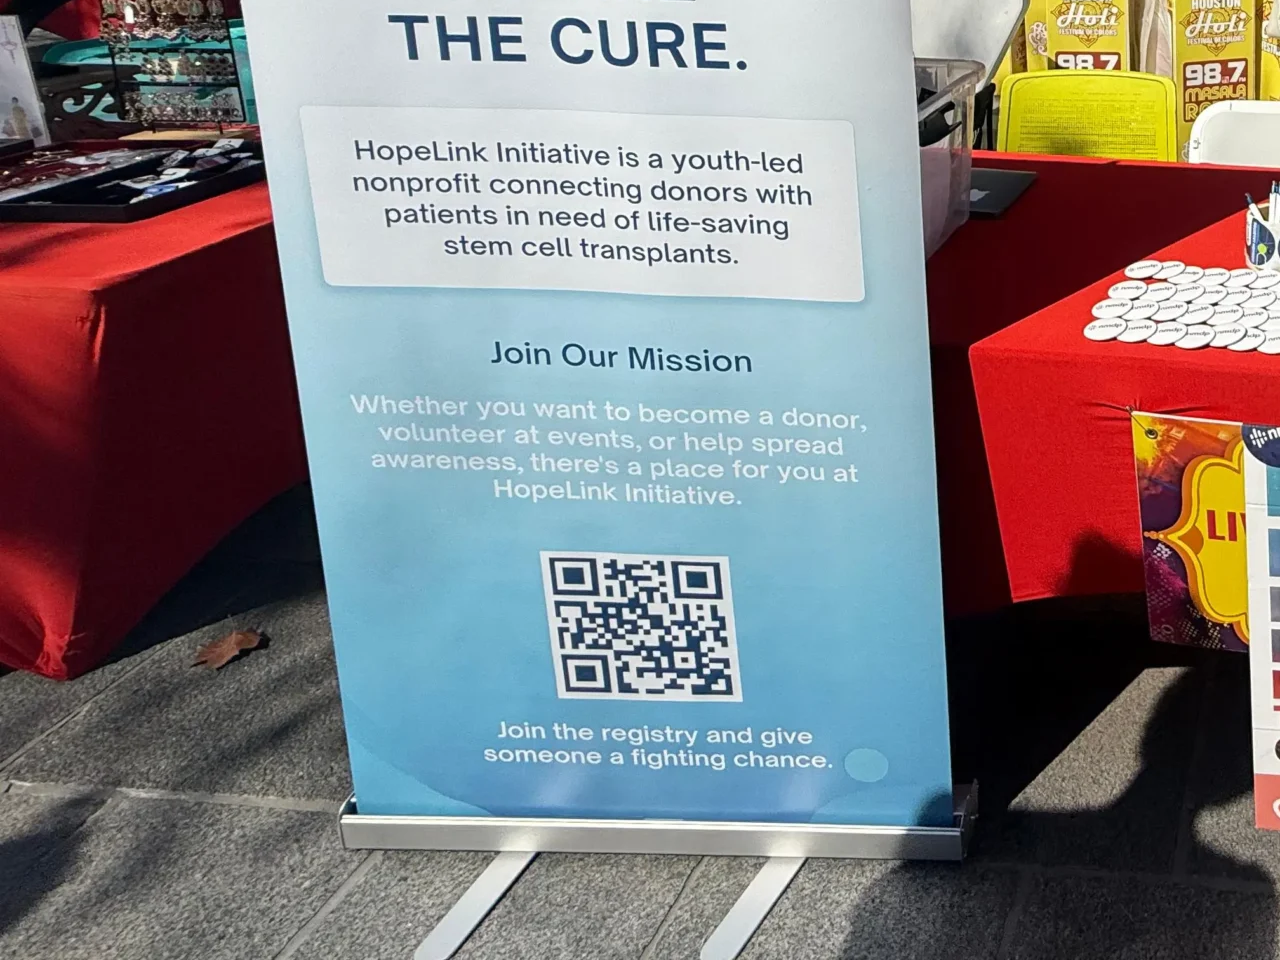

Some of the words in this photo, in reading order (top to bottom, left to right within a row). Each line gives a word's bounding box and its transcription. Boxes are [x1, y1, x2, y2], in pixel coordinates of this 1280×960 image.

[1056, 2, 1119, 28] Holi
[1185, 12, 1247, 37] Holi
[388, 15, 527, 62] THE
[551, 18, 747, 70] CURE.
[1058, 28, 1084, 36] FESTIVAL
[1095, 28, 1118, 36] COLORS
[1187, 36, 1213, 45] FESTIVAL
[1222, 34, 1245, 43] COLORS
[1185, 61, 1246, 86] 98.7
[1185, 84, 1246, 102] MASALA
[354, 140, 489, 165] HopeLink
[497, 142, 610, 166] Initiative
[618, 146, 639, 167] is
[648, 153, 663, 168] a
[671, 150, 803, 174] youth-led
[353, 173, 481, 197] nonprofit
[489, 177, 642, 204] connecting
[651, 180, 747, 202] donors
[756, 184, 812, 206] with
[385, 203, 498, 227] patients
[506, 205, 529, 225] in
[539, 208, 606, 228] need
[614, 211, 640, 230] of
[648, 211, 788, 240] life-saving
[444, 235, 512, 256] stem
[522, 237, 573, 257] cell
[579, 238, 738, 267] transplants.
[491, 341, 551, 365] Join
[562, 343, 618, 367] Our
[628, 347, 752, 372] Mission
[350, 395, 468, 416] Whether
[476, 401, 526, 421] you
[533, 401, 597, 420] want
[603, 401, 631, 421] to
[639, 403, 751, 424] become
[759, 411, 773, 426] a
[782, 408, 867, 436] donor,
[378, 423, 506, 444] volunteer
[514, 425, 540, 444] at
[548, 428, 642, 452] events,
[649, 436, 677, 450] or
[684, 432, 743, 456] help
[752, 437, 843, 460] spread
[372, 454, 524, 475] awareness,
[529, 452, 619, 474] there's
[628, 461, 642, 475] a
[650, 458, 724, 481] place
[732, 460, 770, 479] for
[776, 465, 825, 484] you
[834, 464, 858, 482] at
[494, 479, 618, 503] HopeLink
[626, 483, 742, 505] Initiative.
[1206, 509, 1246, 542] LI
[498, 721, 545, 740] Join
[552, 723, 596, 744] the
[602, 725, 698, 747] registry
[706, 727, 753, 744] and
[761, 727, 813, 748] give
[484, 749, 602, 765] someone
[610, 752, 624, 765] a
[630, 748, 726, 771] fighting
[733, 750, 833, 768] chance.
